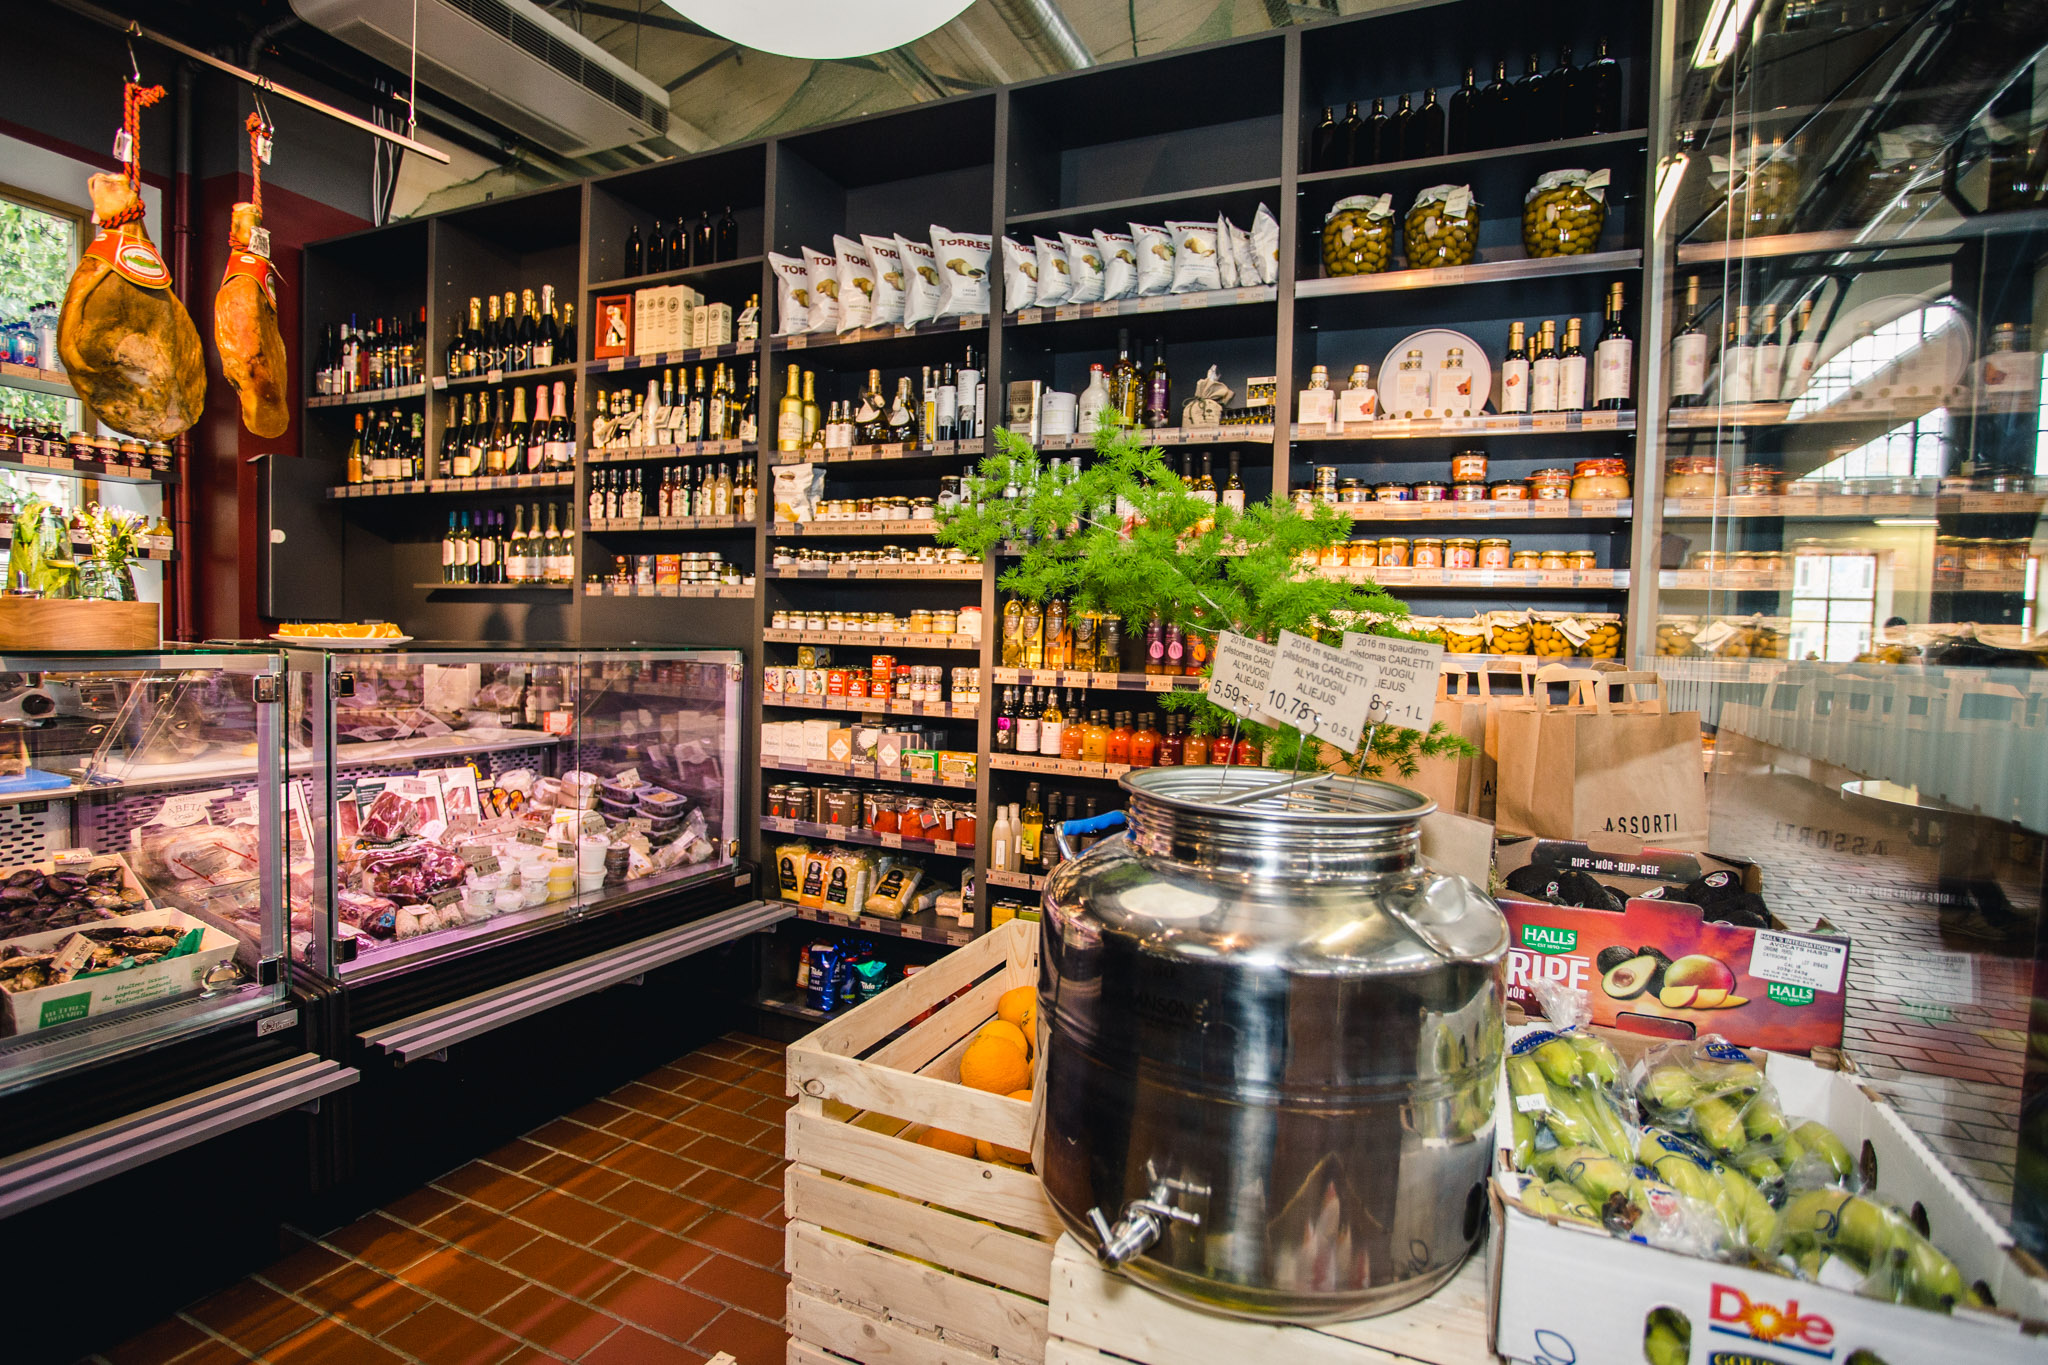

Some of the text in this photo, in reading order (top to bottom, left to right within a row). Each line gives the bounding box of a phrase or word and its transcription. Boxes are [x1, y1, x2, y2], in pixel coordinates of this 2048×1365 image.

[939, 239, 990, 250] TORRES
[1230, 636, 1246, 647] 2016
[1356, 637, 1376, 648] 2016
[1388, 643, 1428, 656] spaudimo
[1223, 645, 1274, 669] pilstomas CARL
[1291, 638, 1364, 672] 2016 m spaudimo
[1388, 654, 1434, 670] CARLETTI
[1282, 650, 1368, 688] pilstomas CARLETTI
[1214, 680, 1240, 701] 5,59
[1234, 672, 1265, 691] ALIEJUS
[1374, 679, 1406, 692] IEJUS
[1296, 682, 1336, 706] ALIEJUS
[1268, 690, 1310, 720] 10,78
[1332, 722, 1347, 738] 0,5
[1349, 730, 1355, 742] L
[1406, 705, 1411, 717] 1
[1416, 706, 1423, 720] L
[1603, 814, 1678, 834] ASSORTI
[1572, 858, 1660, 876] RIPE MÛR RIJP REIF
[1524, 928, 1575, 946] HALLS
[1770, 942, 1805, 952] AVOCATS
[1508, 952, 1590, 992] RIPE
[1770, 984, 1814, 999] HALLS
[1709, 1282, 1834, 1345] Dole
